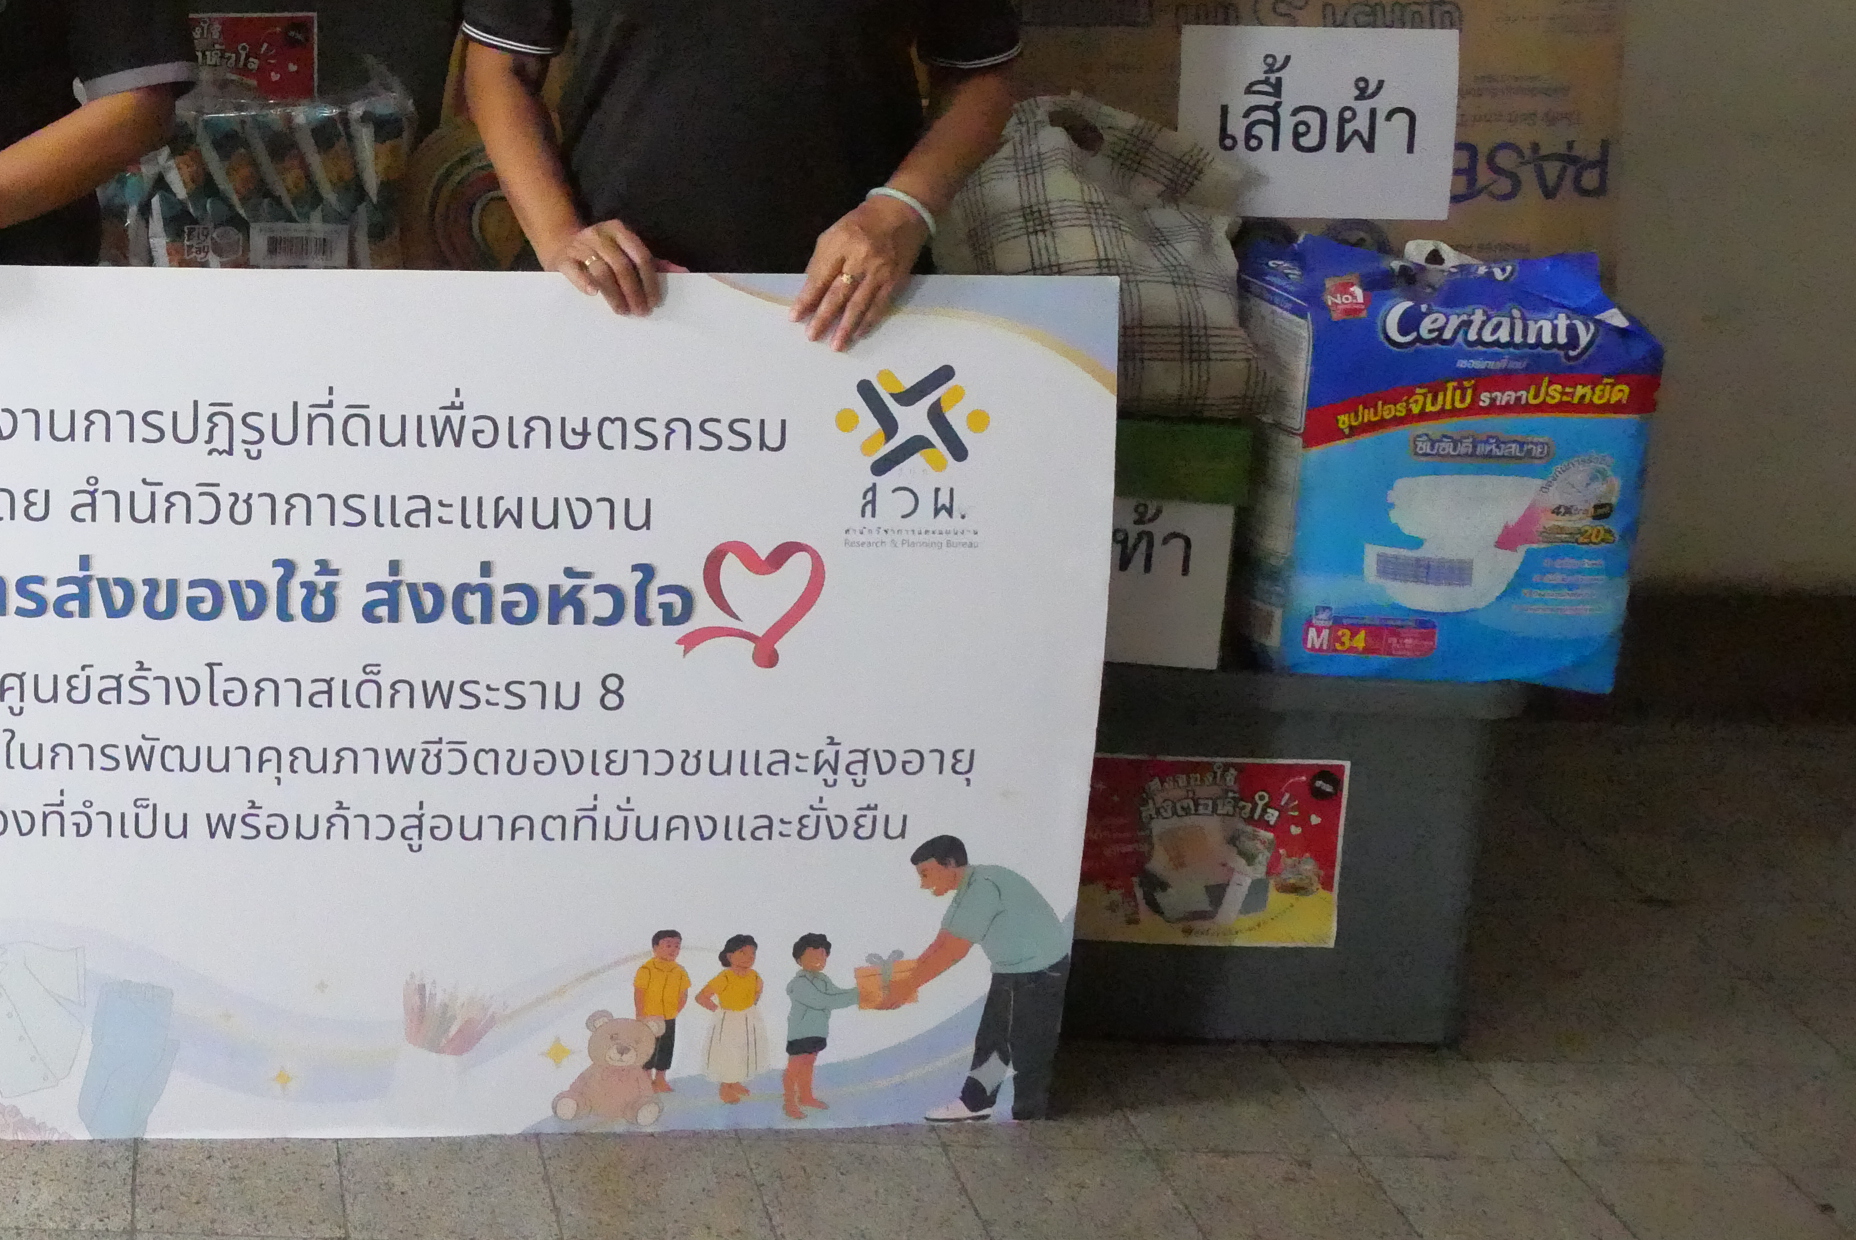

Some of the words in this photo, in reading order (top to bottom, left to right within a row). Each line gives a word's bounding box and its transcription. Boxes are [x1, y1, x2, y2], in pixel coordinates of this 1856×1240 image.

[1218, 53, 1417, 154] เสื้อผ้า
[1384, 301, 1597, 356] Certainty
[69, 476, 654, 532] สำนักวิชาการและแผนงาน
[844, 538, 887, 548] Research
[901, 538, 943, 550] Planning
[945, 539, 980, 549] Bureau
[360, 561, 697, 629] ส่งต่อหัวใจ
[1306, 627, 1330, 650] M
[1334, 628, 1367, 651] 34
[0, 659, 581, 717] ศูนย์สร้างโอกาสเด็กพระราม
[599, 674, 627, 713] 8
[206, 794, 909, 854] พร้อมก้าวสู่อนาคตที่มั่นคงและยั่งยืน
